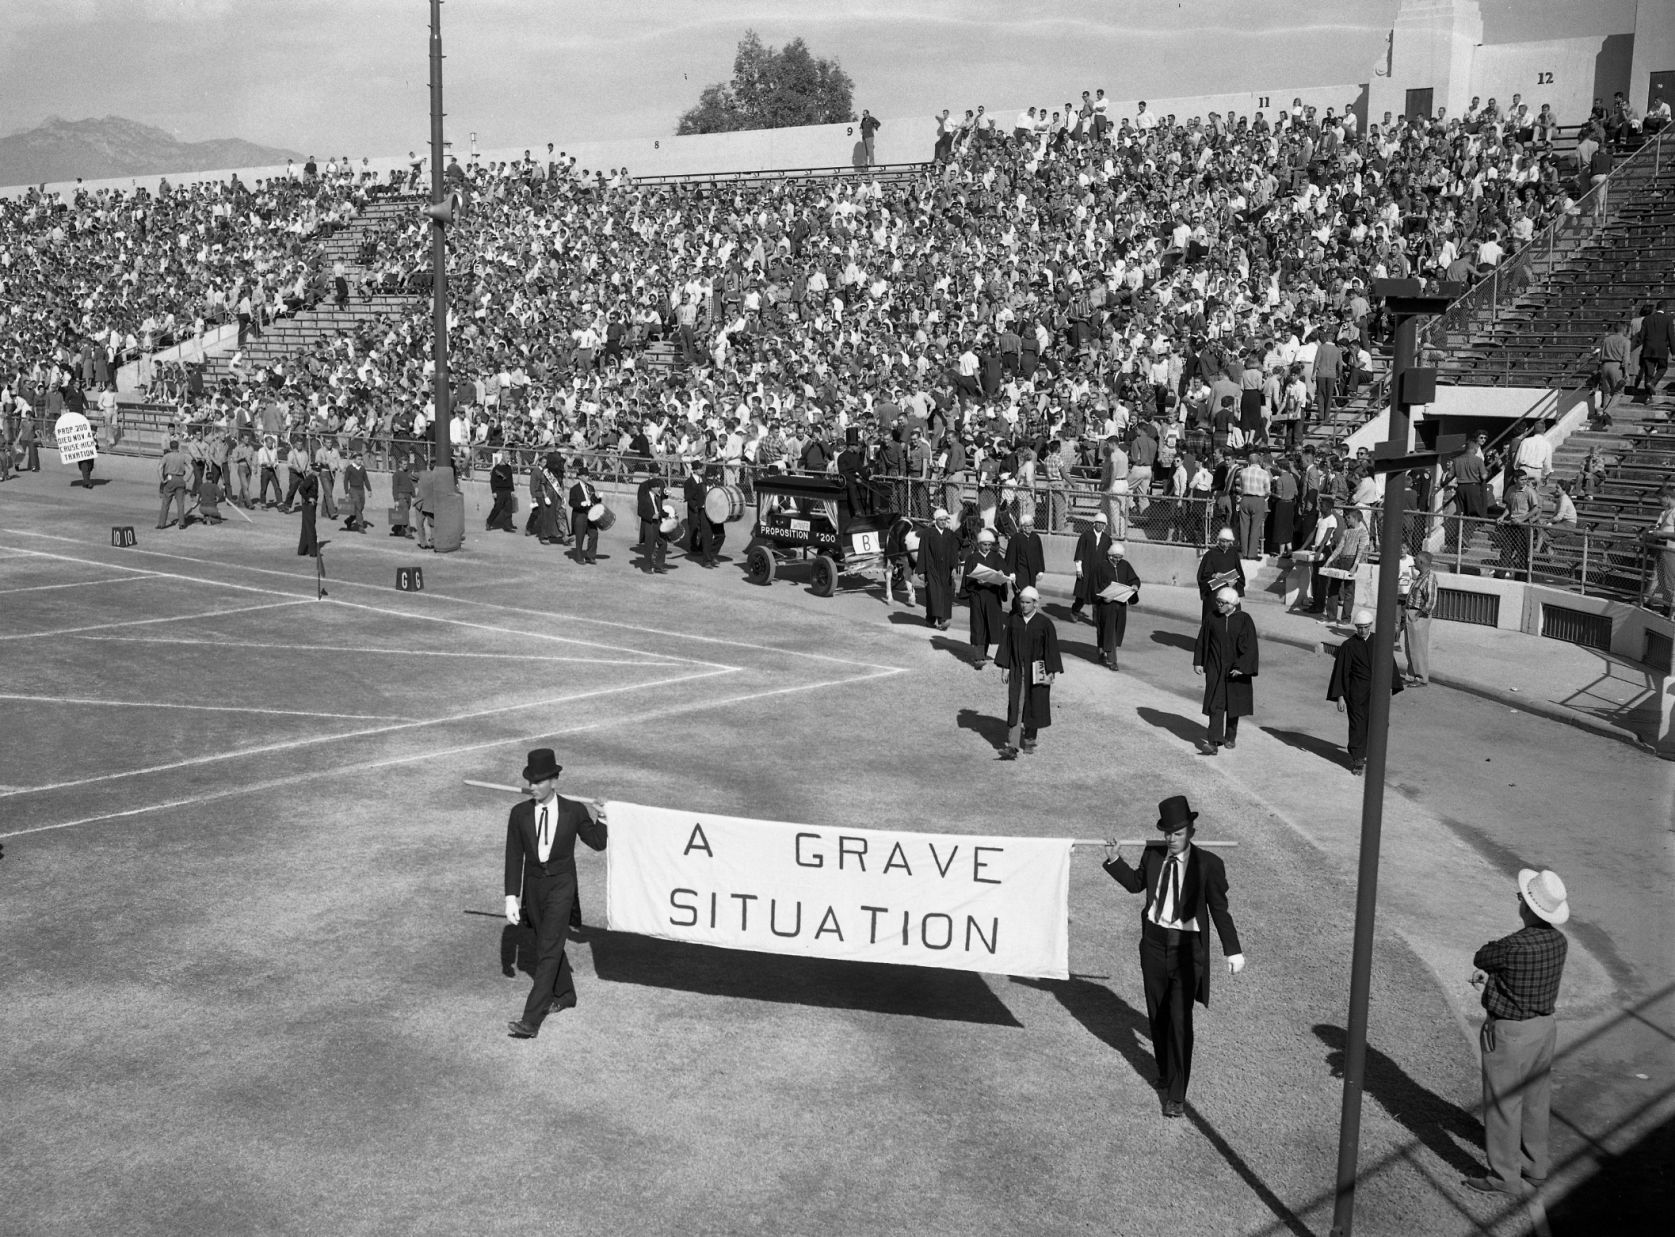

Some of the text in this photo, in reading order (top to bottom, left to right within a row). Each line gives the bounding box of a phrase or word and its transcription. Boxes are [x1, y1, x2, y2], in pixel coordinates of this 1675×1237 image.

[1537, 71, 1554, 85] 12
[1258, 96, 1270, 108] 11
[847, 126, 853, 136] 9
[654, 140, 660, 150] 8
[57, 426, 73, 434] PROP
[58, 436, 72, 444] DIED
[73, 433, 85, 441] NOV
[59, 443, 79, 453] CAUSE
[64, 449, 94, 460] TAXATION
[113, 530, 133, 546] 10 10
[760, 525, 809, 540] PROPOSITION
[861, 534, 871, 551] B
[401, 571, 421, 589] G G
[683, 822, 1004, 885] A GRAVE
[669, 887, 1000, 955] SITUATION
